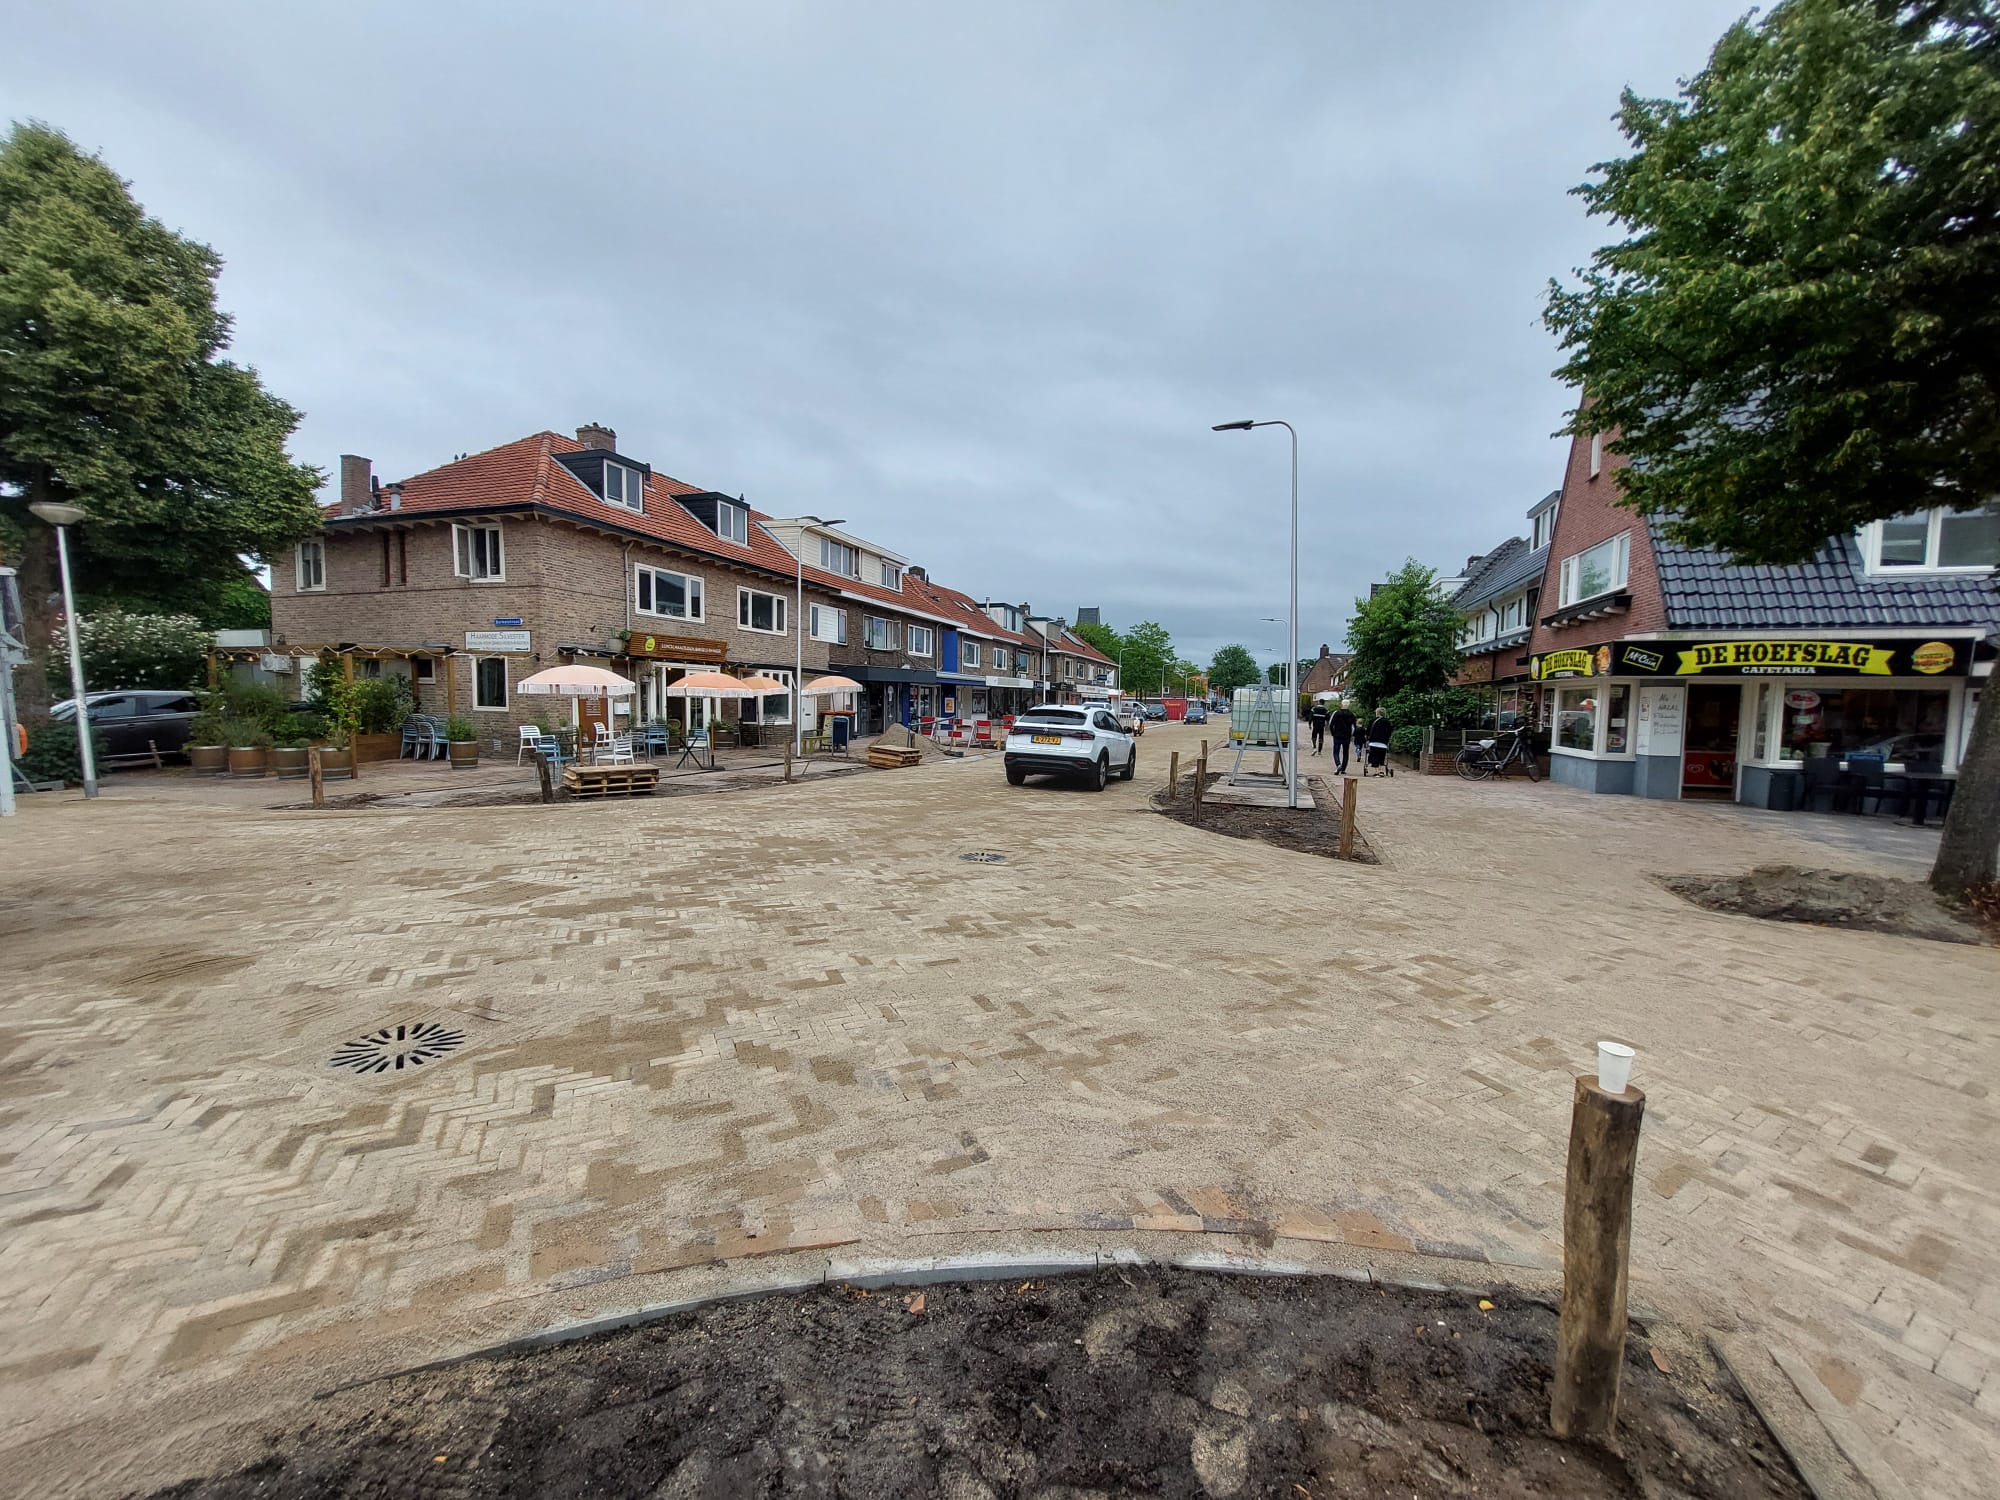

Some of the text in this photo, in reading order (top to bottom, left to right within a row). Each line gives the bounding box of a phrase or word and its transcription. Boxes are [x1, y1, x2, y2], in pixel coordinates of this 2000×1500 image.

[1545, 651, 1587, 671] DE HOEFSLAG
[1627, 651, 1657, 668] McCain
[1695, 643, 1871, 666] DE HOEFSLAG
[1742, 666, 1816, 674] CAFETARIA
